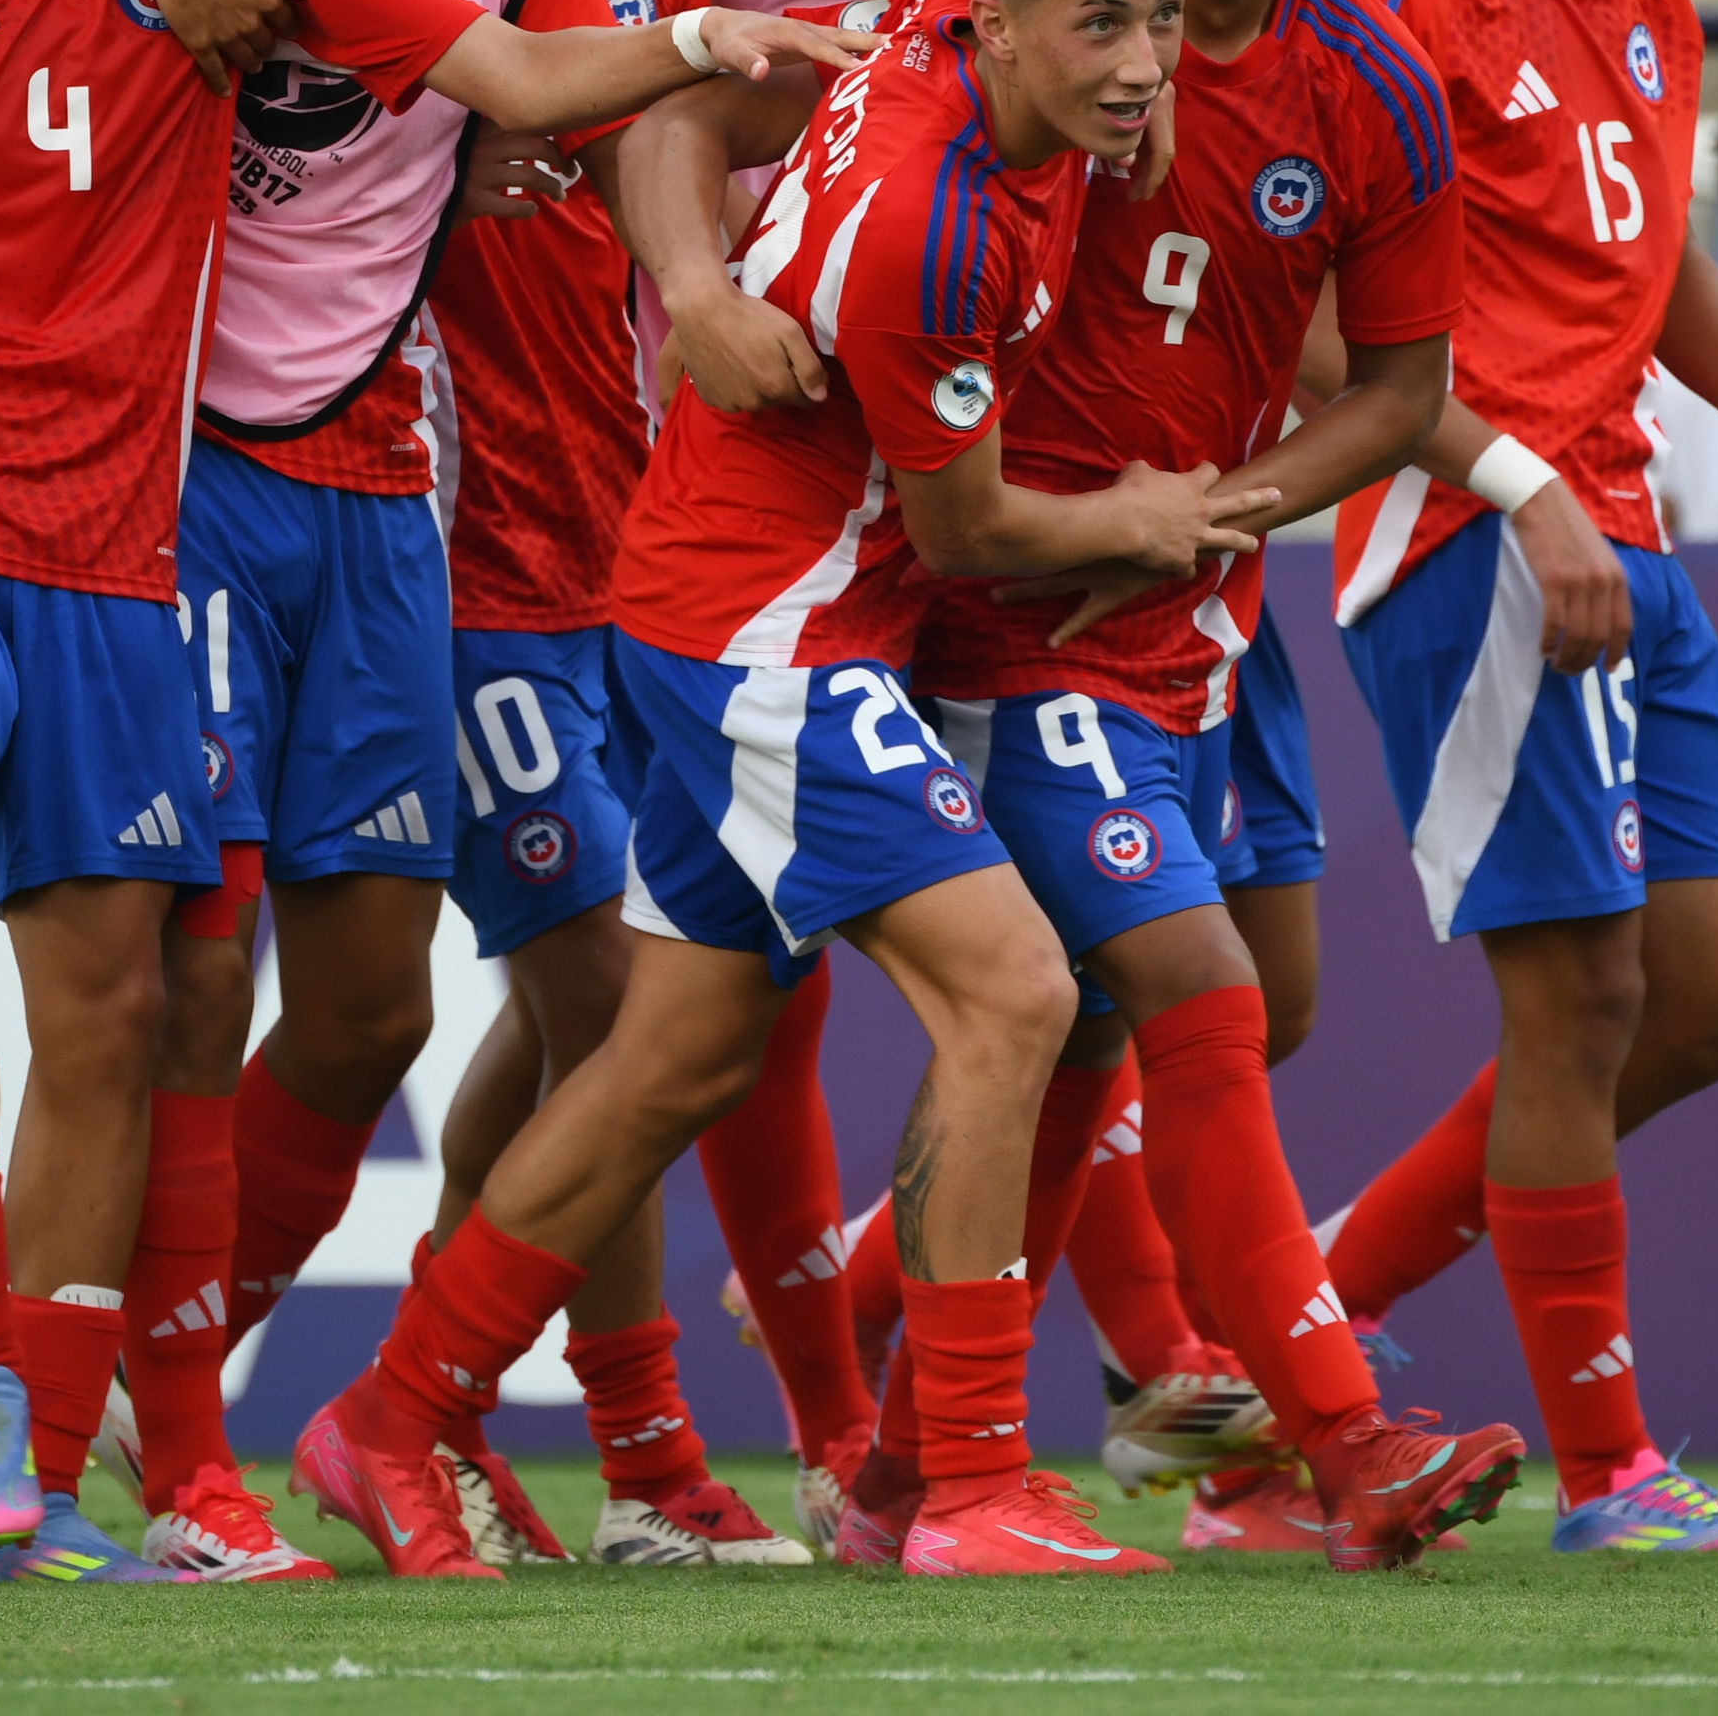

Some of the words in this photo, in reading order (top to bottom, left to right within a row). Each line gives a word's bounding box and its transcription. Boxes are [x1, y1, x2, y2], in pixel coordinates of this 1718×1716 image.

[27, 67, 92, 191] 4
[1577, 120, 1645, 243] 15
[1143, 231, 1210, 345] 9
[456, 676, 561, 819] 10
[828, 667, 956, 775] 2
[1035, 692, 1127, 801] 9
[1582, 656, 1638, 790] 15
